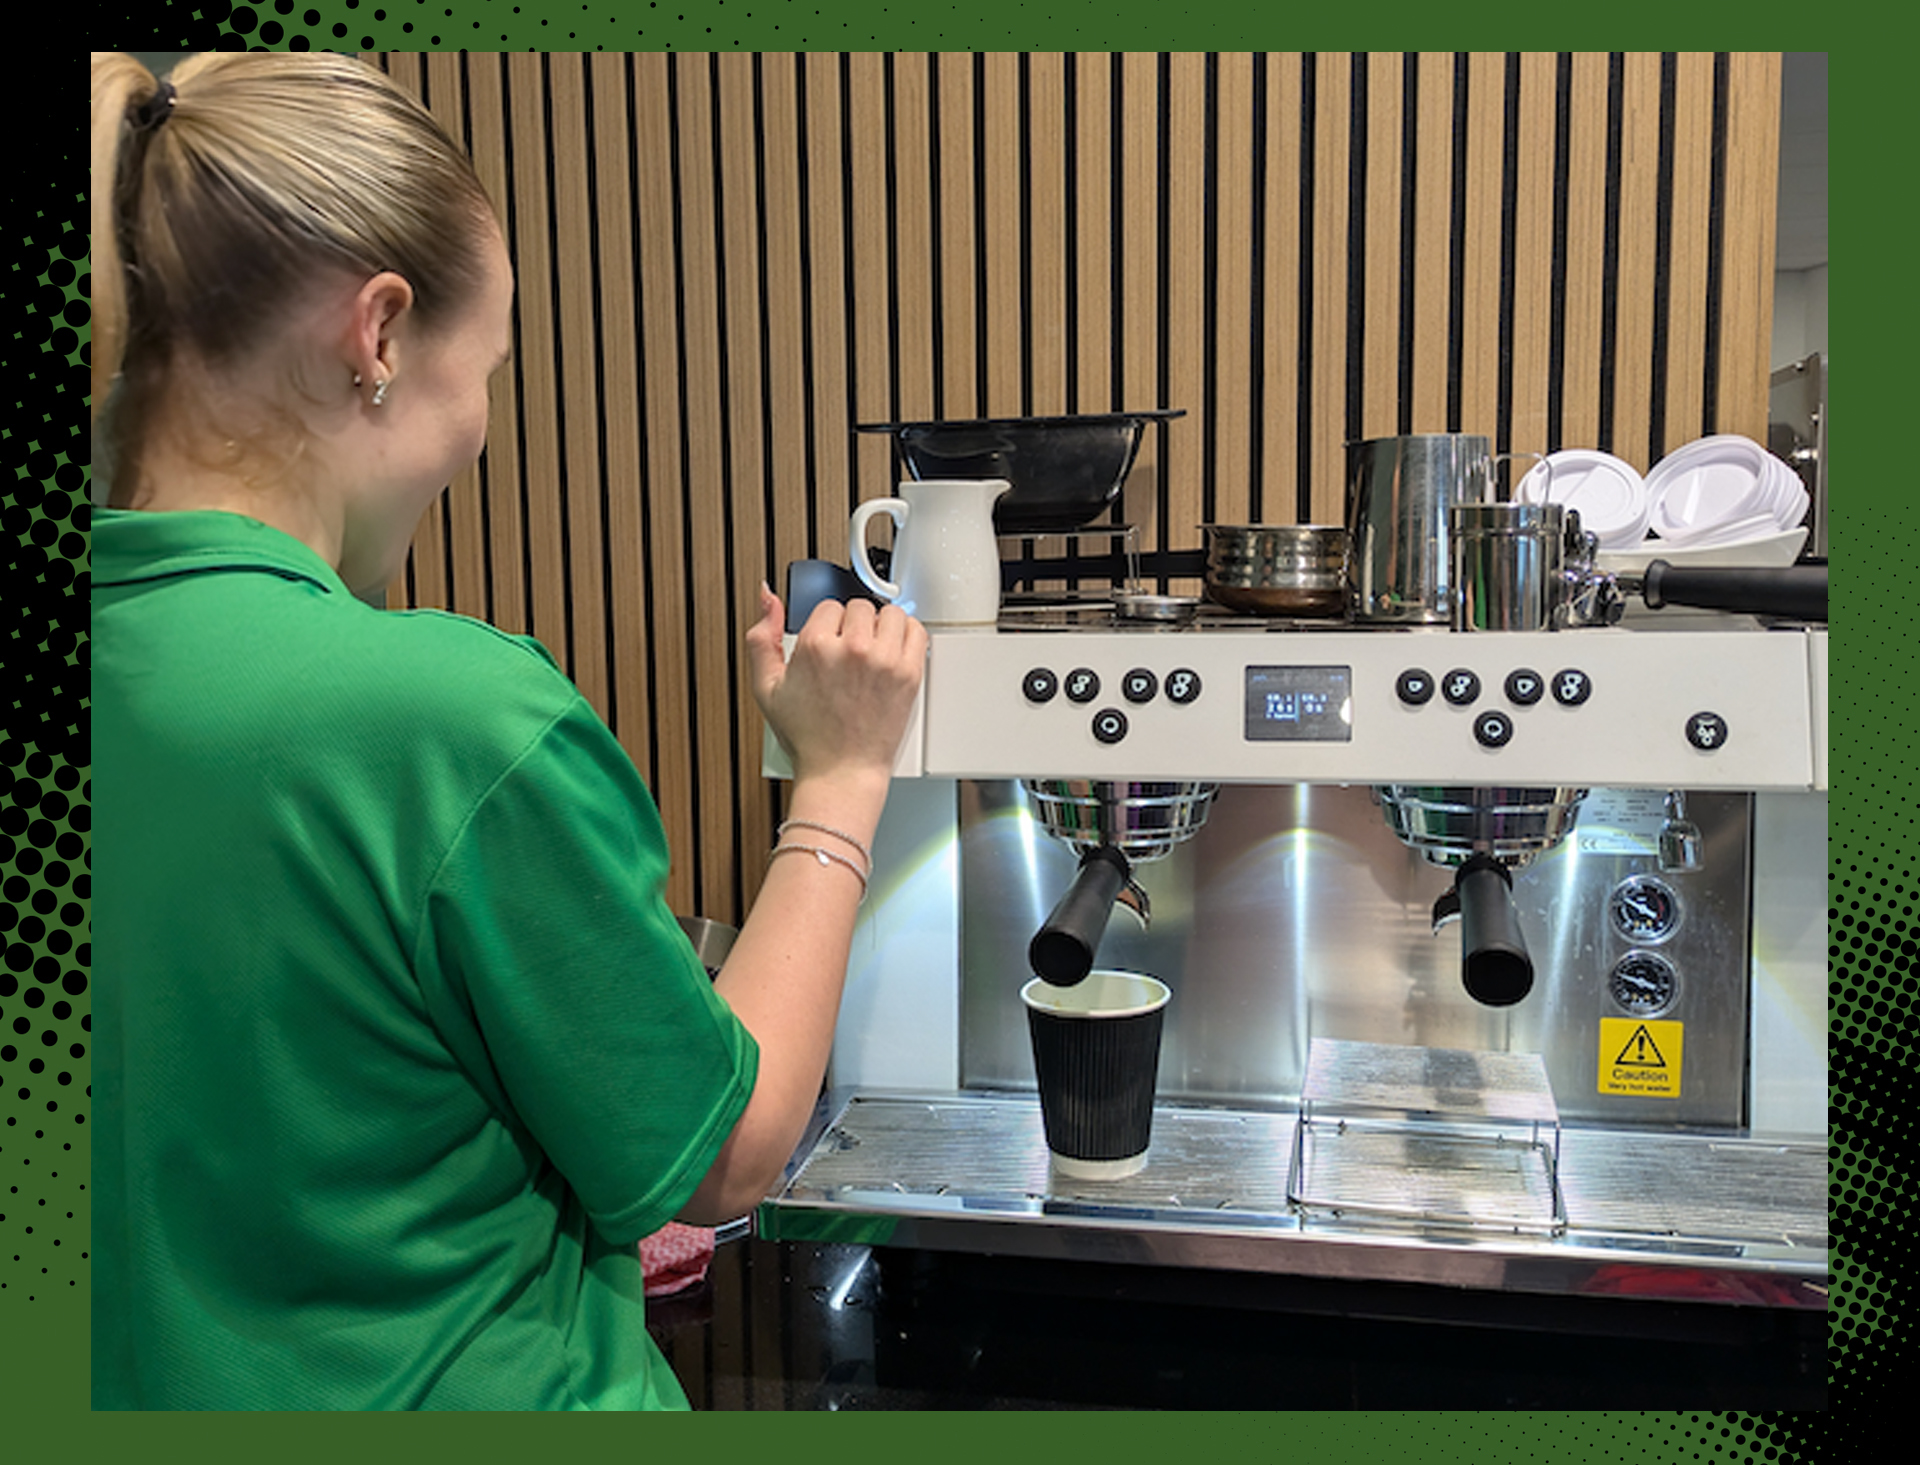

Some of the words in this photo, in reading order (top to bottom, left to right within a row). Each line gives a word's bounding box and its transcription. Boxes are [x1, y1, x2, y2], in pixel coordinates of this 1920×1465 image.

[1612, 1067, 1668, 1082] Caution
[1608, 1082, 1627, 1091] Very
[1629, 1082, 1645, 1091] hot
